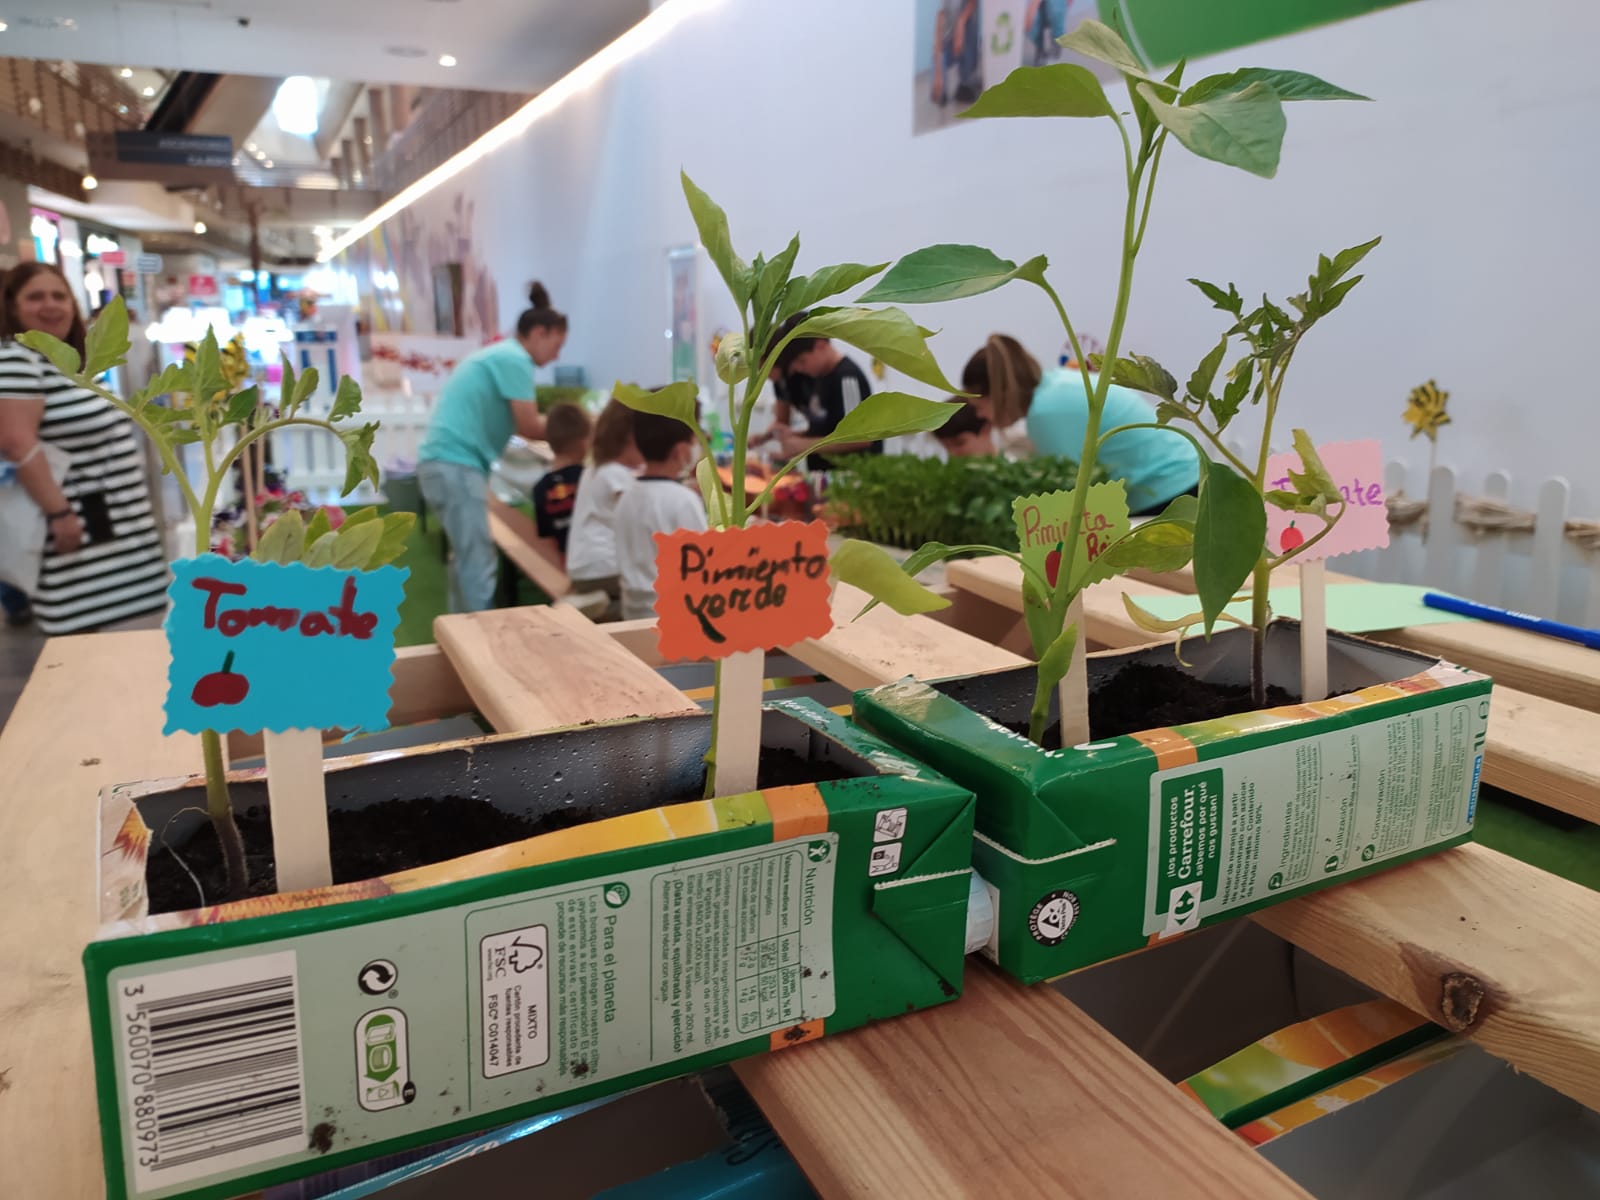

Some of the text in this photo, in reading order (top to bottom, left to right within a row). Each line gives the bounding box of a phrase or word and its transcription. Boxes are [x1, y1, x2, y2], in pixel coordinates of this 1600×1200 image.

[680, 541, 827, 585] Pimiento
[191, 576, 378, 640] Tomate
[1195, 780, 1208, 876] sabemos por qué
[1208, 793, 1220, 837] gustan!
[1230, 791, 1239, 818] partir
[1245, 782, 1256, 831] Contenido
[1335, 798, 1347, 851] Utilización
[1371, 769, 1386, 840] Conservación
[1168, 796, 1180, 877] ¡los productos
[1178, 785, 1196, 879] Carrefour,
[1228, 827, 1237, 862] naranja
[1280, 801, 1293, 867] Ingredientes
[1226, 863, 1233, 875] de
[1233, 834, 1243, 890] concentrado
[588, 894, 598, 913] Los
[803, 866, 816, 926] Nutrición
[555, 900, 566, 940] procede
[567, 915, 576, 939] este
[586, 915, 598, 959] bosques
[494, 945, 506, 978] FSC
[556, 954, 566, 995] recursos
[587, 960, 599, 1007] protegen
[600, 914, 617, 1024] Para el planeta
[670, 946, 681, 1000] equilibrada
[527, 1003, 537, 1040] MIXTO
[568, 990, 578, 1049] certificado
[590, 1007, 599, 1047] nuestro
[488, 1021, 499, 1068] C014047
[124, 984, 159, 1167] 3 560070 880973
